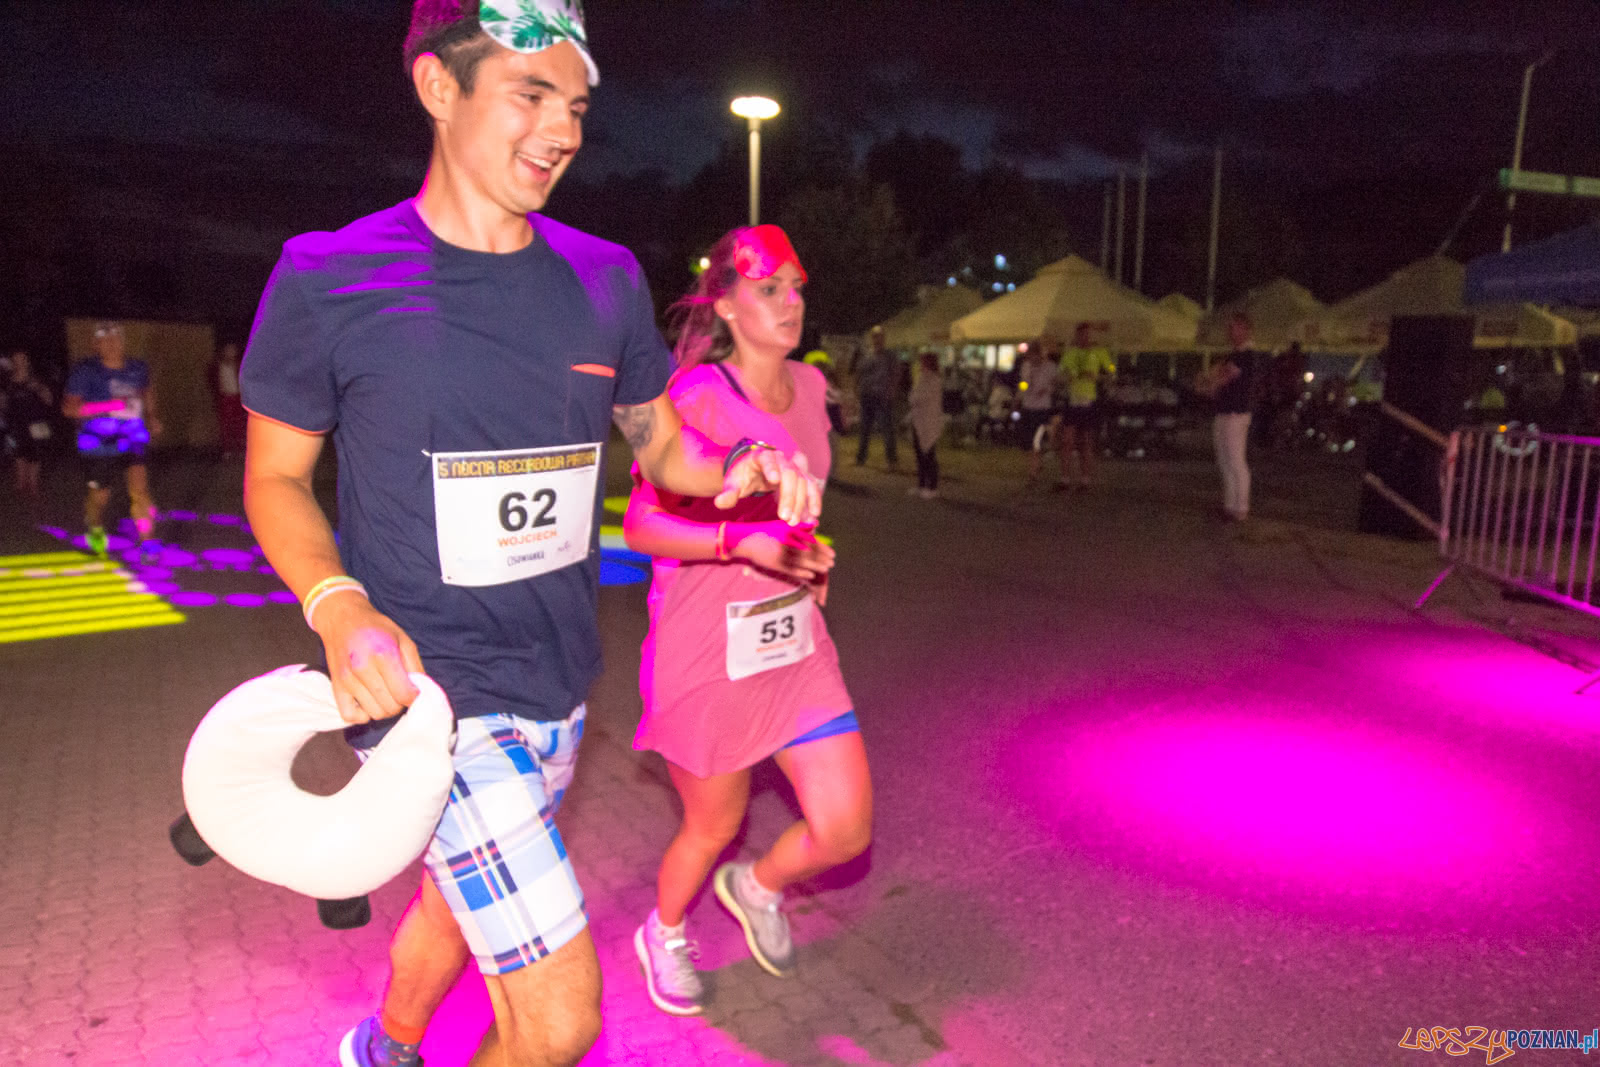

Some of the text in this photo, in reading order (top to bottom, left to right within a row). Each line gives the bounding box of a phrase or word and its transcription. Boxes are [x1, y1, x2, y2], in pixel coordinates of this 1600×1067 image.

[498, 488, 557, 532] 62
[498, 530, 558, 547] WOJCIECH
[760, 615, 795, 644] 53
